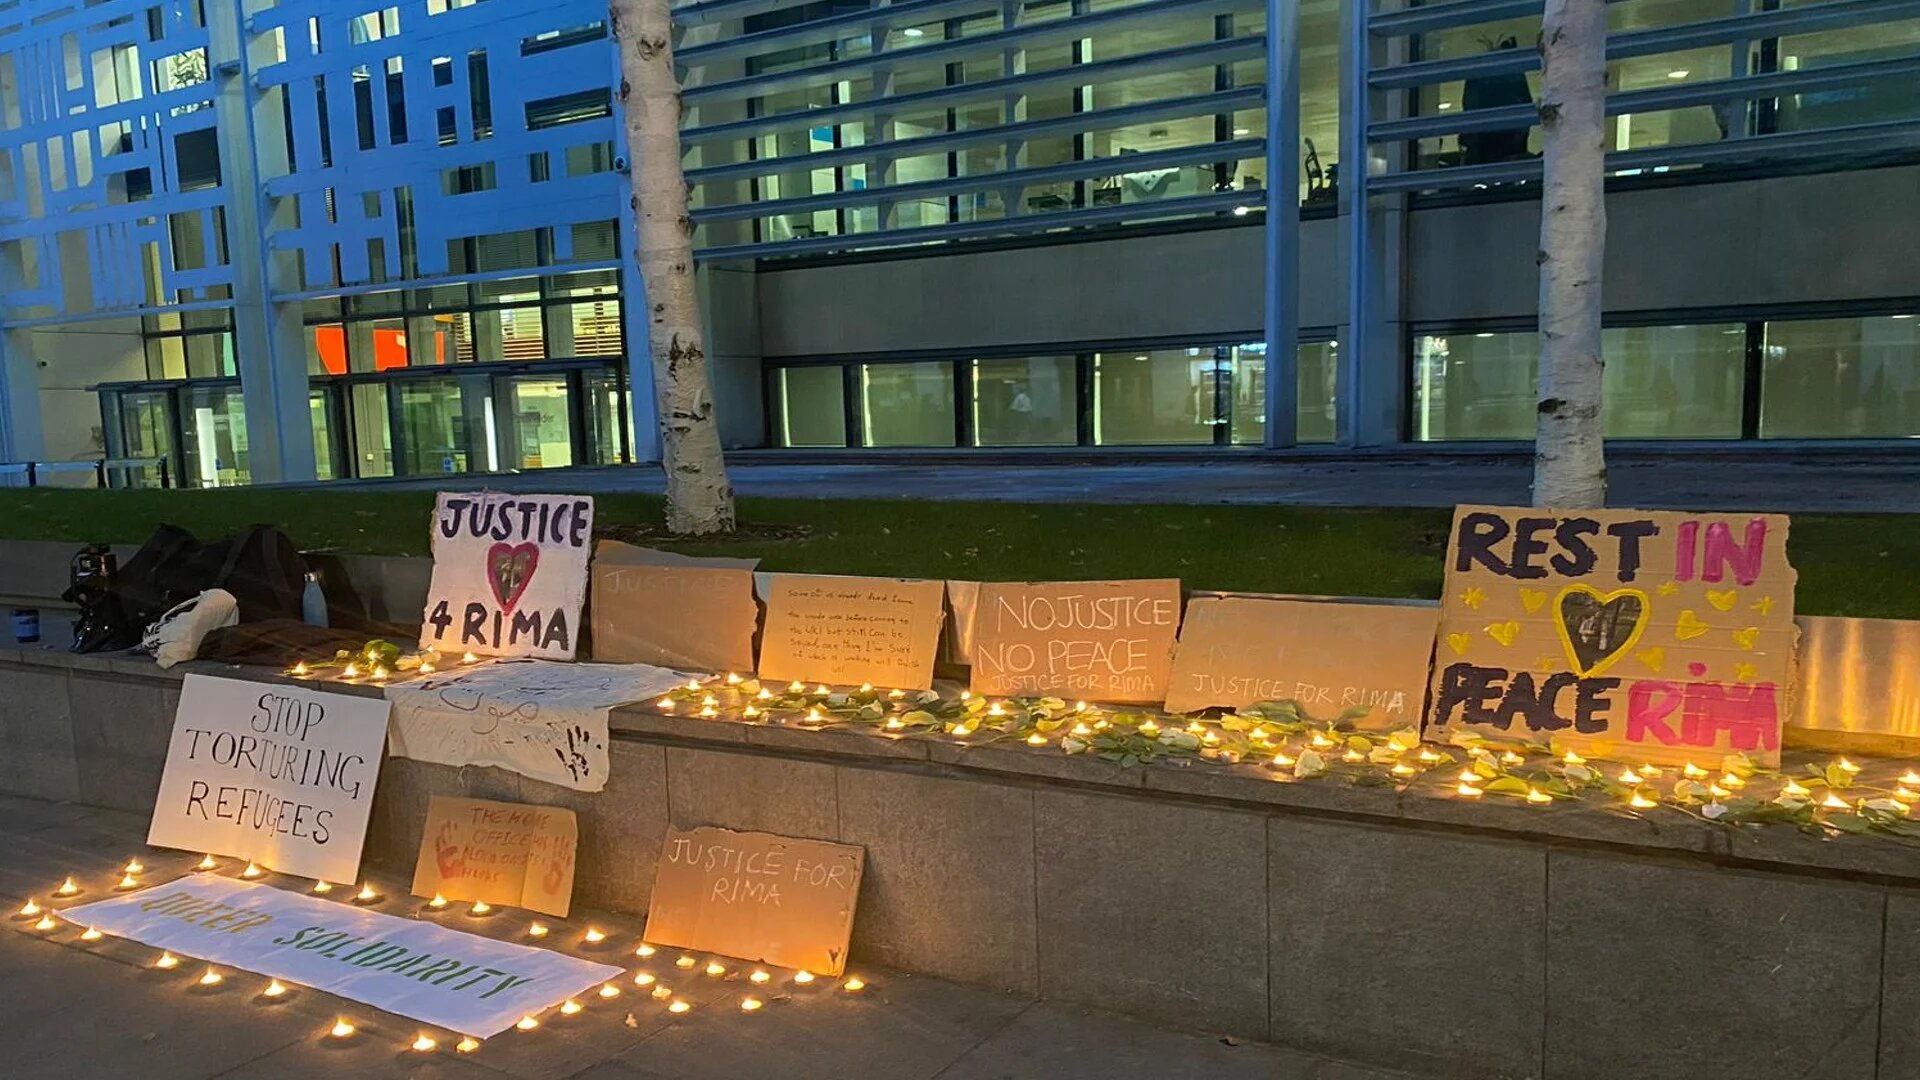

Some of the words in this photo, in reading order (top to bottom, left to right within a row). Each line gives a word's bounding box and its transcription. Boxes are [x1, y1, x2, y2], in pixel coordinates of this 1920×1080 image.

[440, 500, 590, 547] JUSTICE
[1456, 512, 1660, 583] REST
[1675, 516, 1767, 586] IN
[429, 600, 451, 639] 4
[462, 602, 569, 651] RIMA
[978, 643, 1035, 675] NO
[1048, 638, 1149, 675] PEACE
[991, 674, 1063, 691] JUSTICE
[1067, 675, 1101, 690] FOR
[1109, 674, 1154, 692] RIMA
[1192, 673, 1285, 699] JUSTICE
[1294, 682, 1333, 704] FOR
[1341, 686, 1408, 714] RIMA
[1434, 662, 1621, 734] PEACE
[251, 692, 325, 742] STOP
[185, 728, 364, 800] TORTURING
[186, 781, 334, 844] REFUGEES
[471, 807, 506, 824] THE
[472, 829, 530, 846] OFFICE
[668, 838, 787, 876] JUSTICE
[793, 859, 846, 889] FOR
[711, 877, 782, 908] RIMA
[140, 891, 274, 934] QUEER
[272, 926, 535, 999] SOLIDARITY
